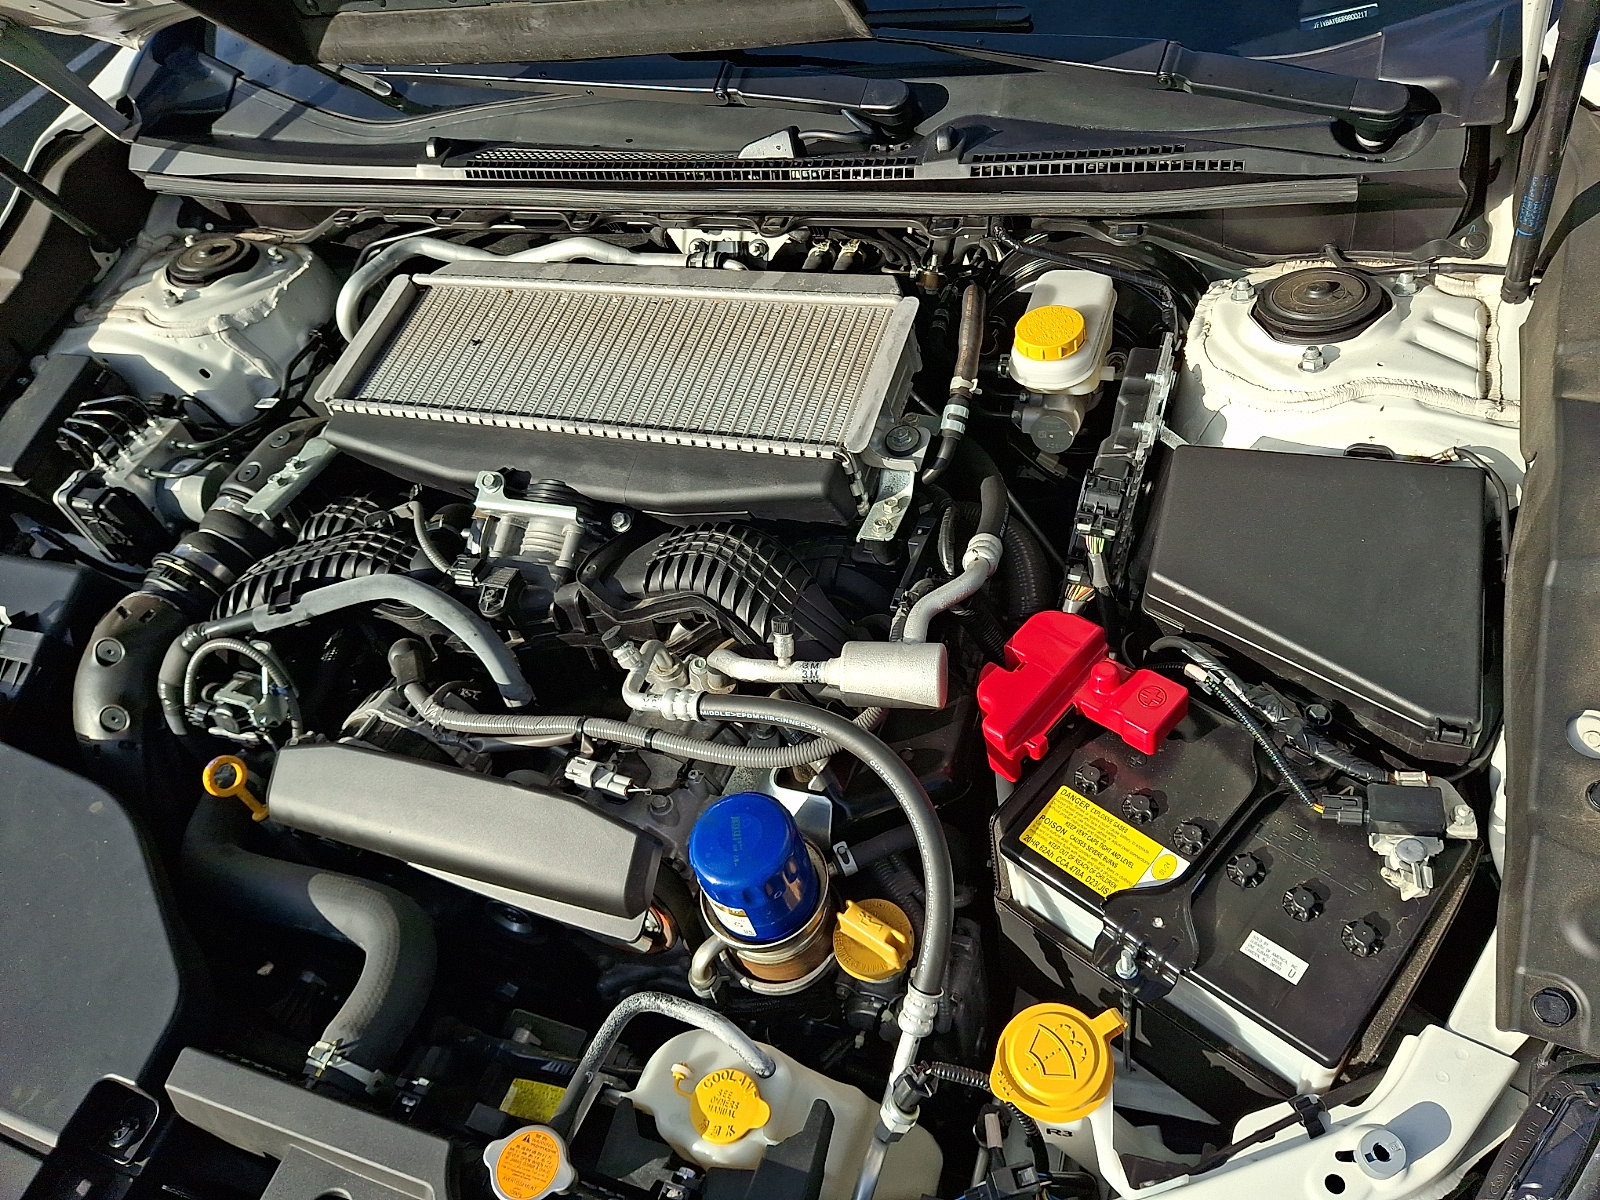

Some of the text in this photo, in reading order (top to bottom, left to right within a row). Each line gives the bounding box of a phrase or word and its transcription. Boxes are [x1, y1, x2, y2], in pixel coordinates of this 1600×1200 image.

[1059, 787, 1090, 810] DANGER
[1112, 821, 1128, 834] GASES
[1022, 833, 1040, 848] 20HR
[1038, 843, 1055, 858] 62Ah
[1054, 854, 1070, 868] CCA
[1038, 813, 1119, 868] POISON CAUSES SEVERE BURNS
[1064, 820, 1134, 868] KEEP VENT CAPS TIGHT AND LEVEL
[1047, 840, 1060, 851] KEEP
[1058, 847, 1069, 857] OUT
[1067, 853, 1075, 861] OF
[1073, 857, 1090, 870] REACH
[1088, 867, 1096, 875] OF
[1094, 871, 1118, 889] CHILDREN
[1286, 968, 1296, 979] U
[703, 1069, 760, 1100] COOLANT
[718, 1088, 734, 1100] SEE
[1045, 1128, 1073, 1137] R3
